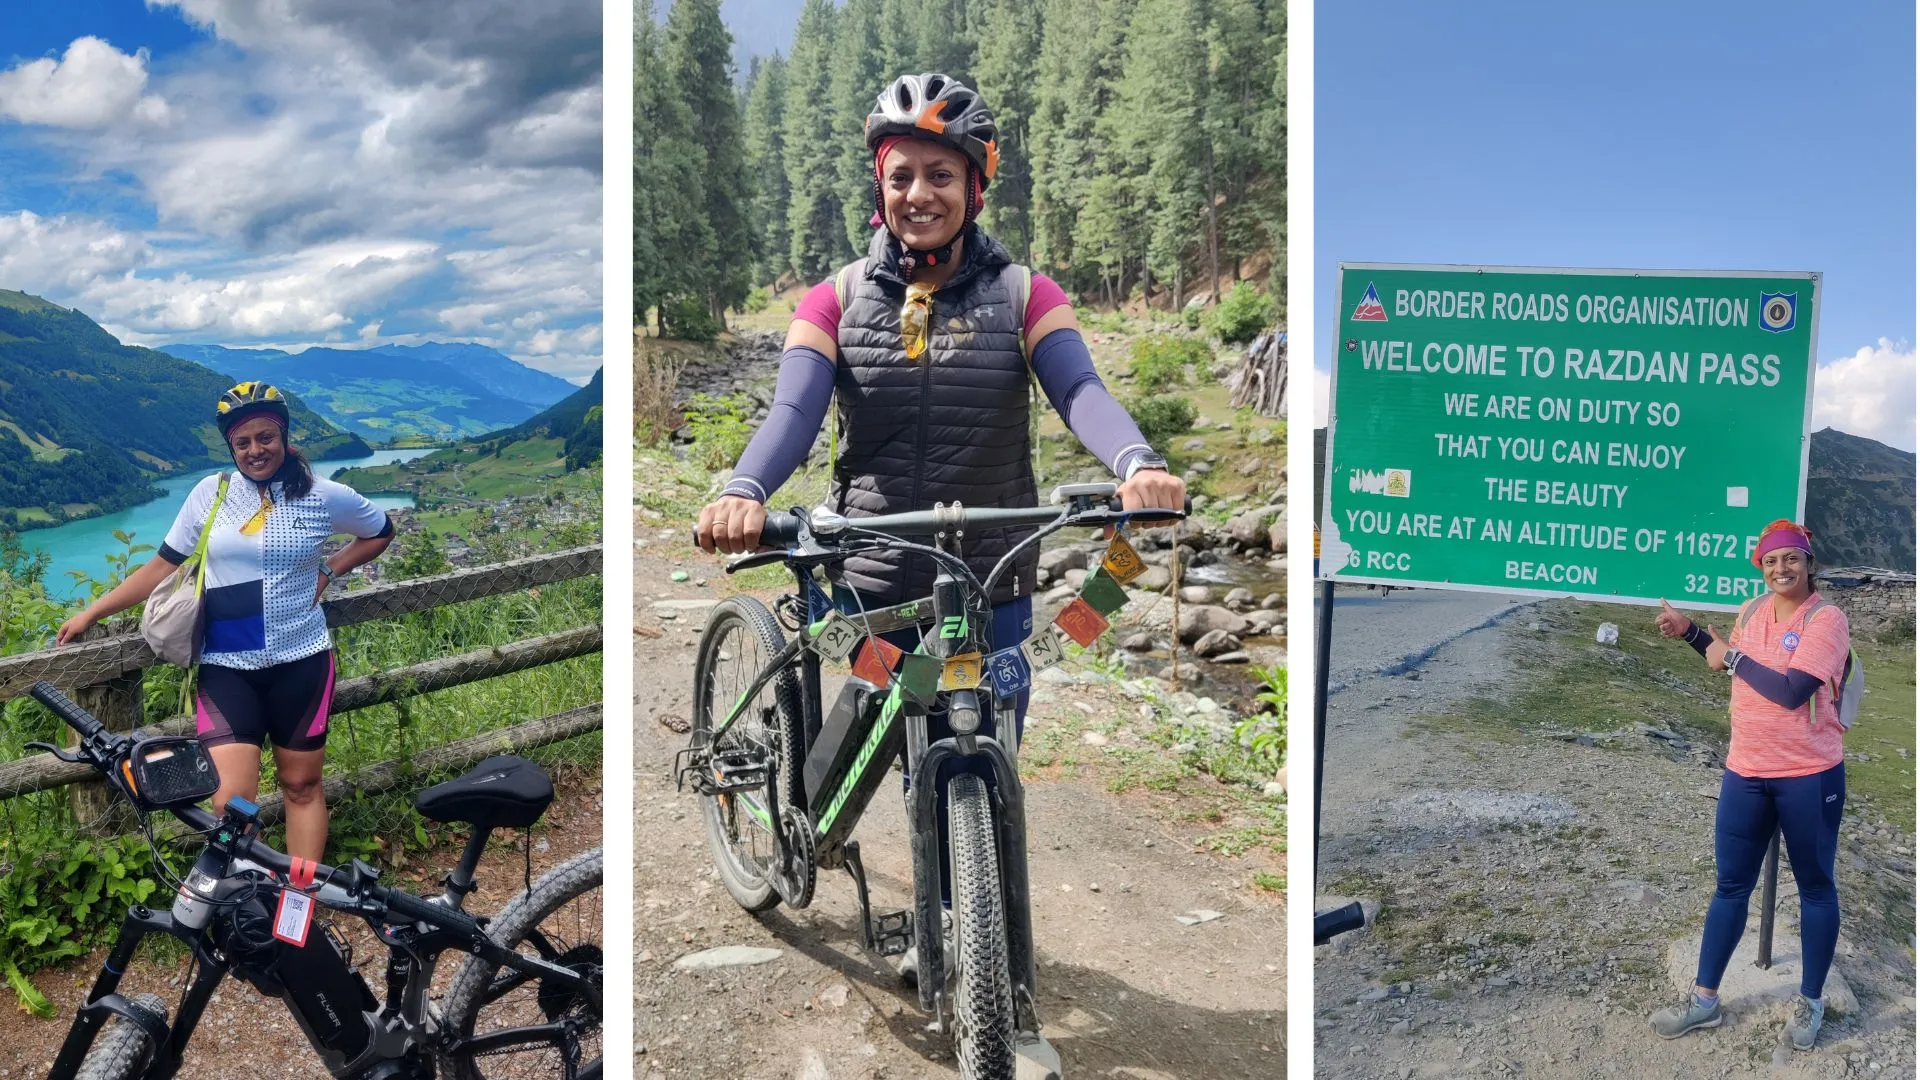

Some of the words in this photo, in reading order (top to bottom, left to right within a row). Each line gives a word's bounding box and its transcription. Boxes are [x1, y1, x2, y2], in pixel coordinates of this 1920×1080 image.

[1396, 289, 1486, 319] BORDER
[1492, 292, 1569, 322] ROADS
[1576, 294, 1749, 327] ORGANISATION
[1361, 340, 1508, 376] WELCOME
[1516, 346, 1556, 379] TO
[1564, 347, 1689, 384] RAZDAN
[1699, 352, 1781, 387] PASS
[1444, 393, 1479, 417] WE
[1484, 395, 1532, 420] ARE
[1538, 397, 1571, 421] ON
[1578, 399, 1641, 425] DUTY
[1647, 401, 1681, 427] SO
[1434, 433, 1492, 458] THAT
[1498, 437, 1545, 462] YOU
[1551, 439, 1600, 465] CAN
[1607, 442, 1687, 470] ENJOY
[1484, 477, 1528, 503] THE
[1535, 480, 1629, 508] BEAUTY
[1346, 509, 1391, 535] YOU
[1396, 513, 1442, 538] ARE
[1447, 516, 1477, 540] AT
[1481, 518, 1512, 542] AN
[1518, 521, 1628, 551] ALTITUDE
[1635, 528, 1667, 553] OF
[1674, 532, 1738, 559] 11672
[1745, 535, 1759, 560] F
[1347, 549, 1361, 568] 6
[1367, 551, 1411, 571] RCC
[1505, 560, 1598, 585] BEACON
[1684, 574, 1709, 594] 32
[316, 992, 341, 1027] FLYER
